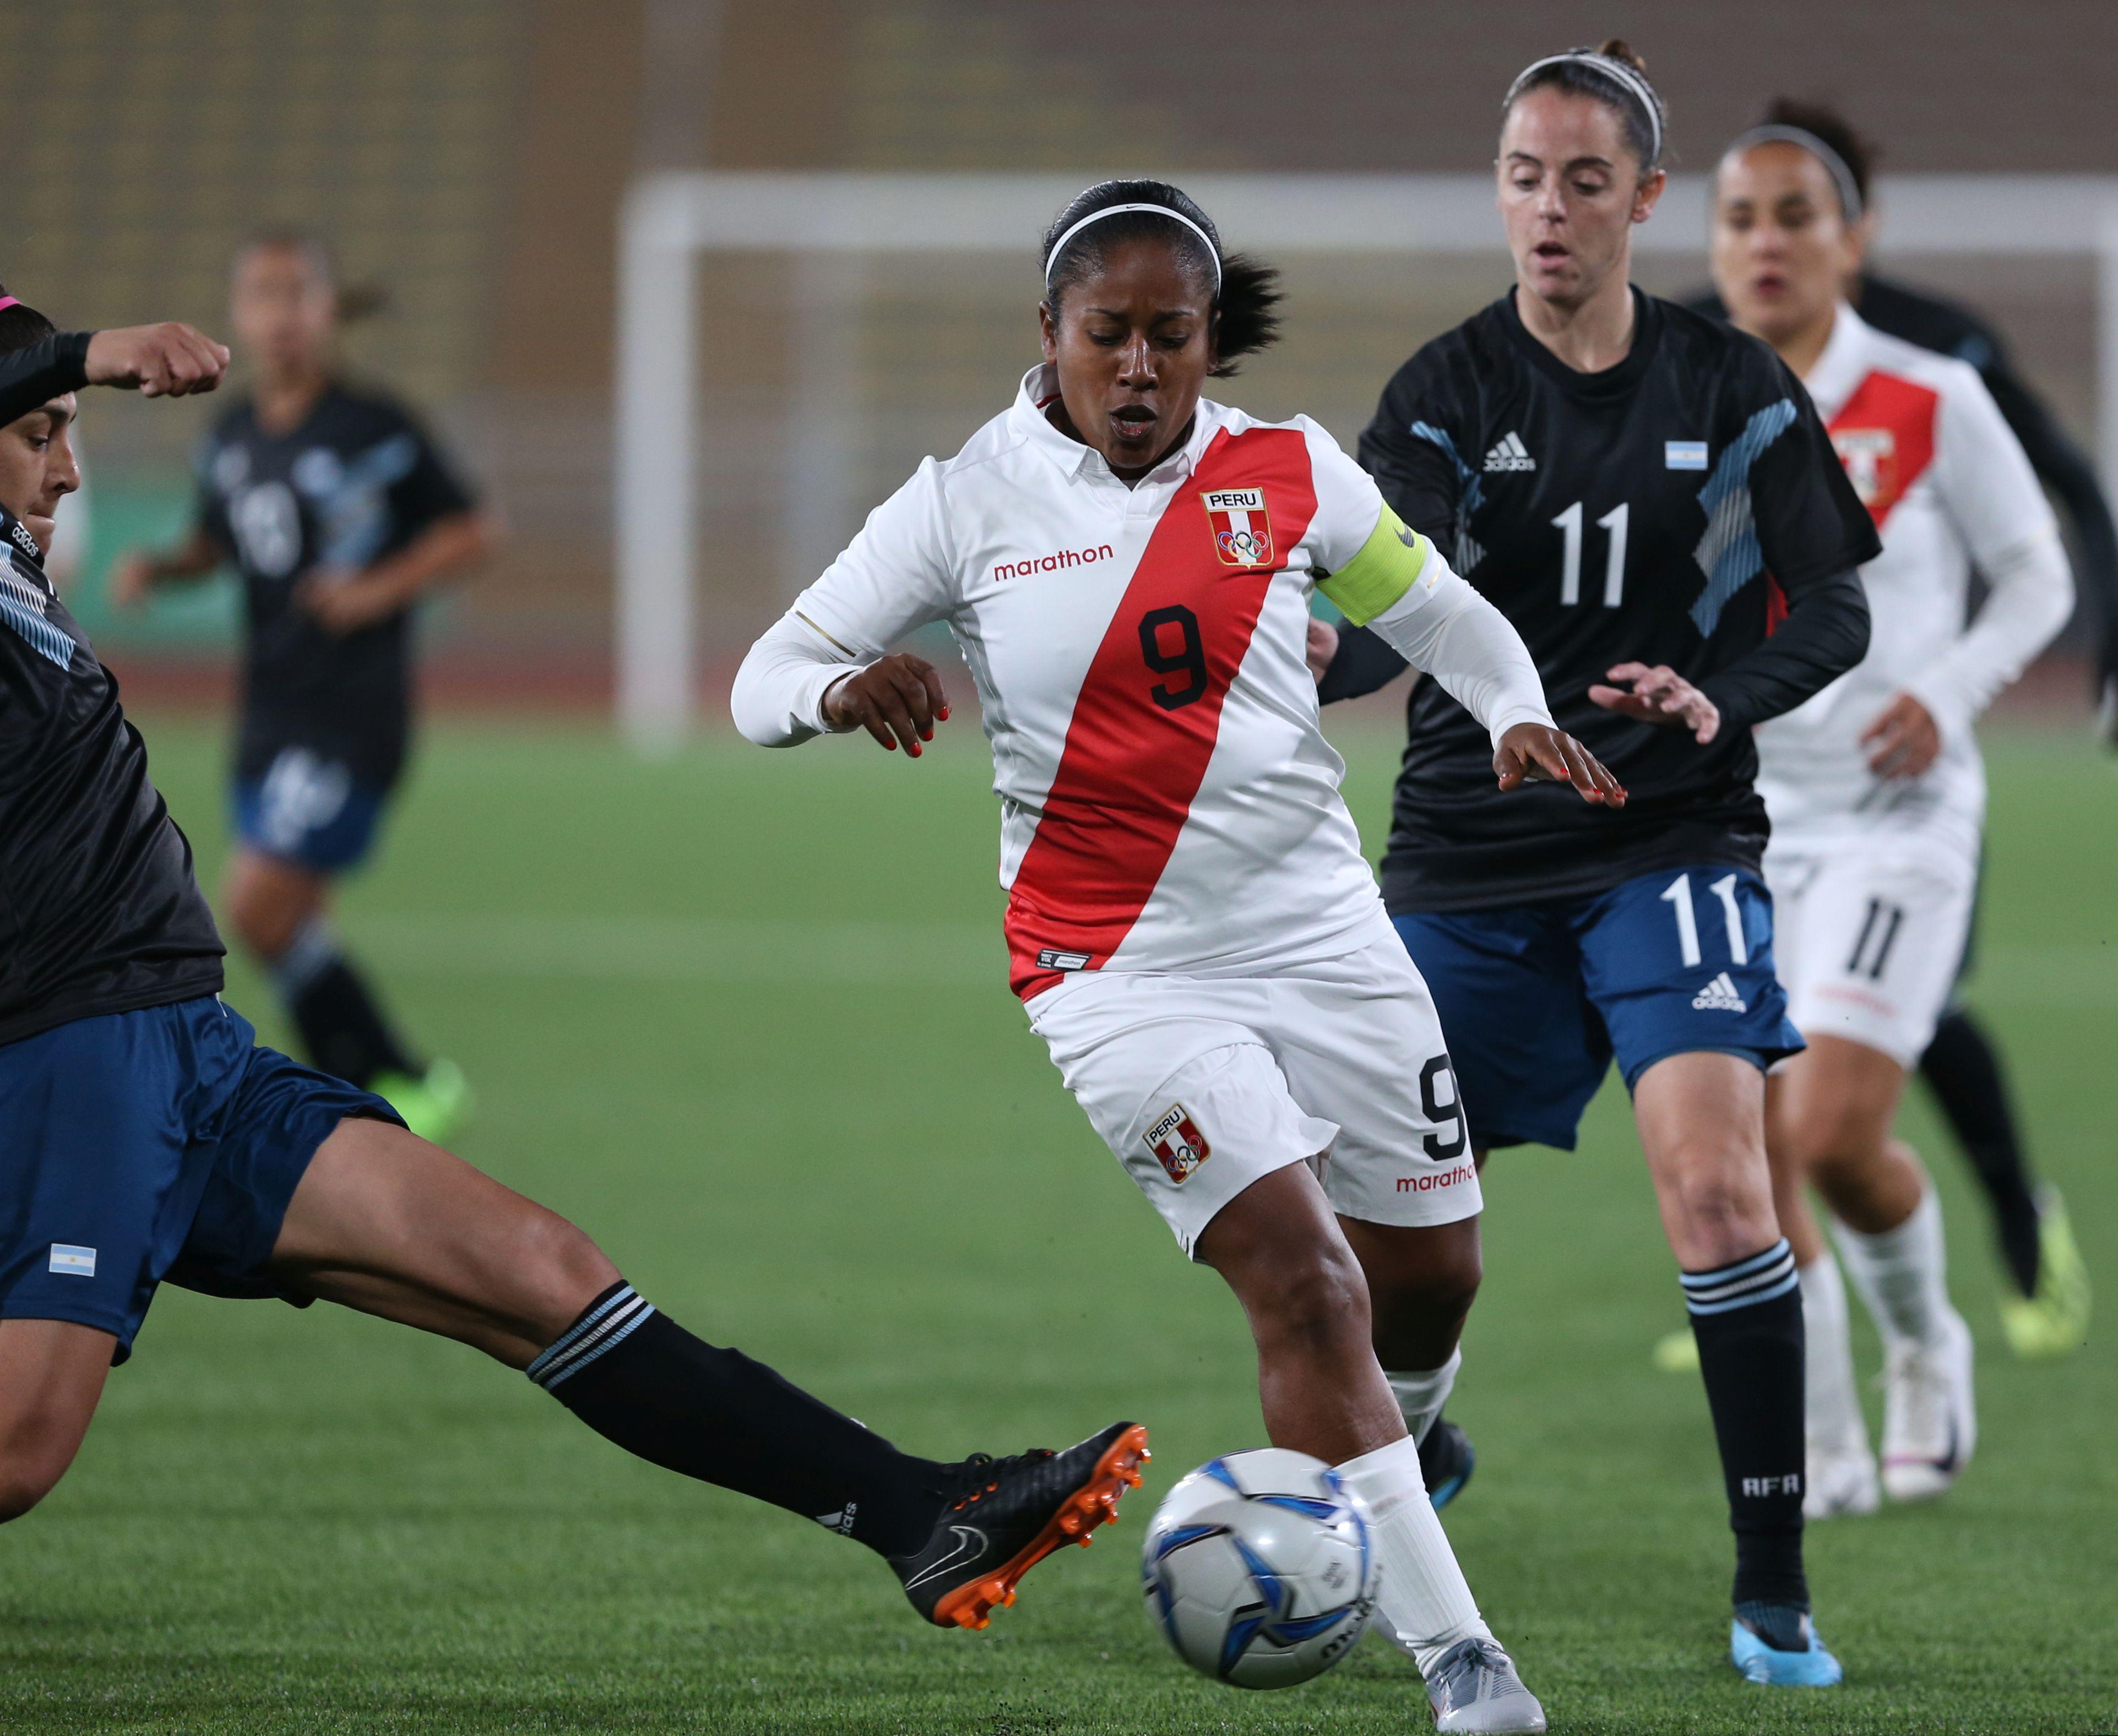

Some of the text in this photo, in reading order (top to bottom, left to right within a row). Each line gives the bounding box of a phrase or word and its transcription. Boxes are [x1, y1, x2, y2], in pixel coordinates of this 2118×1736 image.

[1209, 493, 1257, 508] PERU
[12, 526, 39, 558] adidas
[1550, 500, 1630, 607] 11
[993, 544, 1114, 582] marathon
[1138, 603, 1208, 712] 9
[1659, 872, 1747, 968] 11
[1846, 898, 1902, 980] 11
[1419, 1053, 1466, 1161] 9
[1149, 1111, 1180, 1143] PERU
[1396, 1163, 1475, 1192] maratho
[1742, 1473, 1799, 1498] AFA
